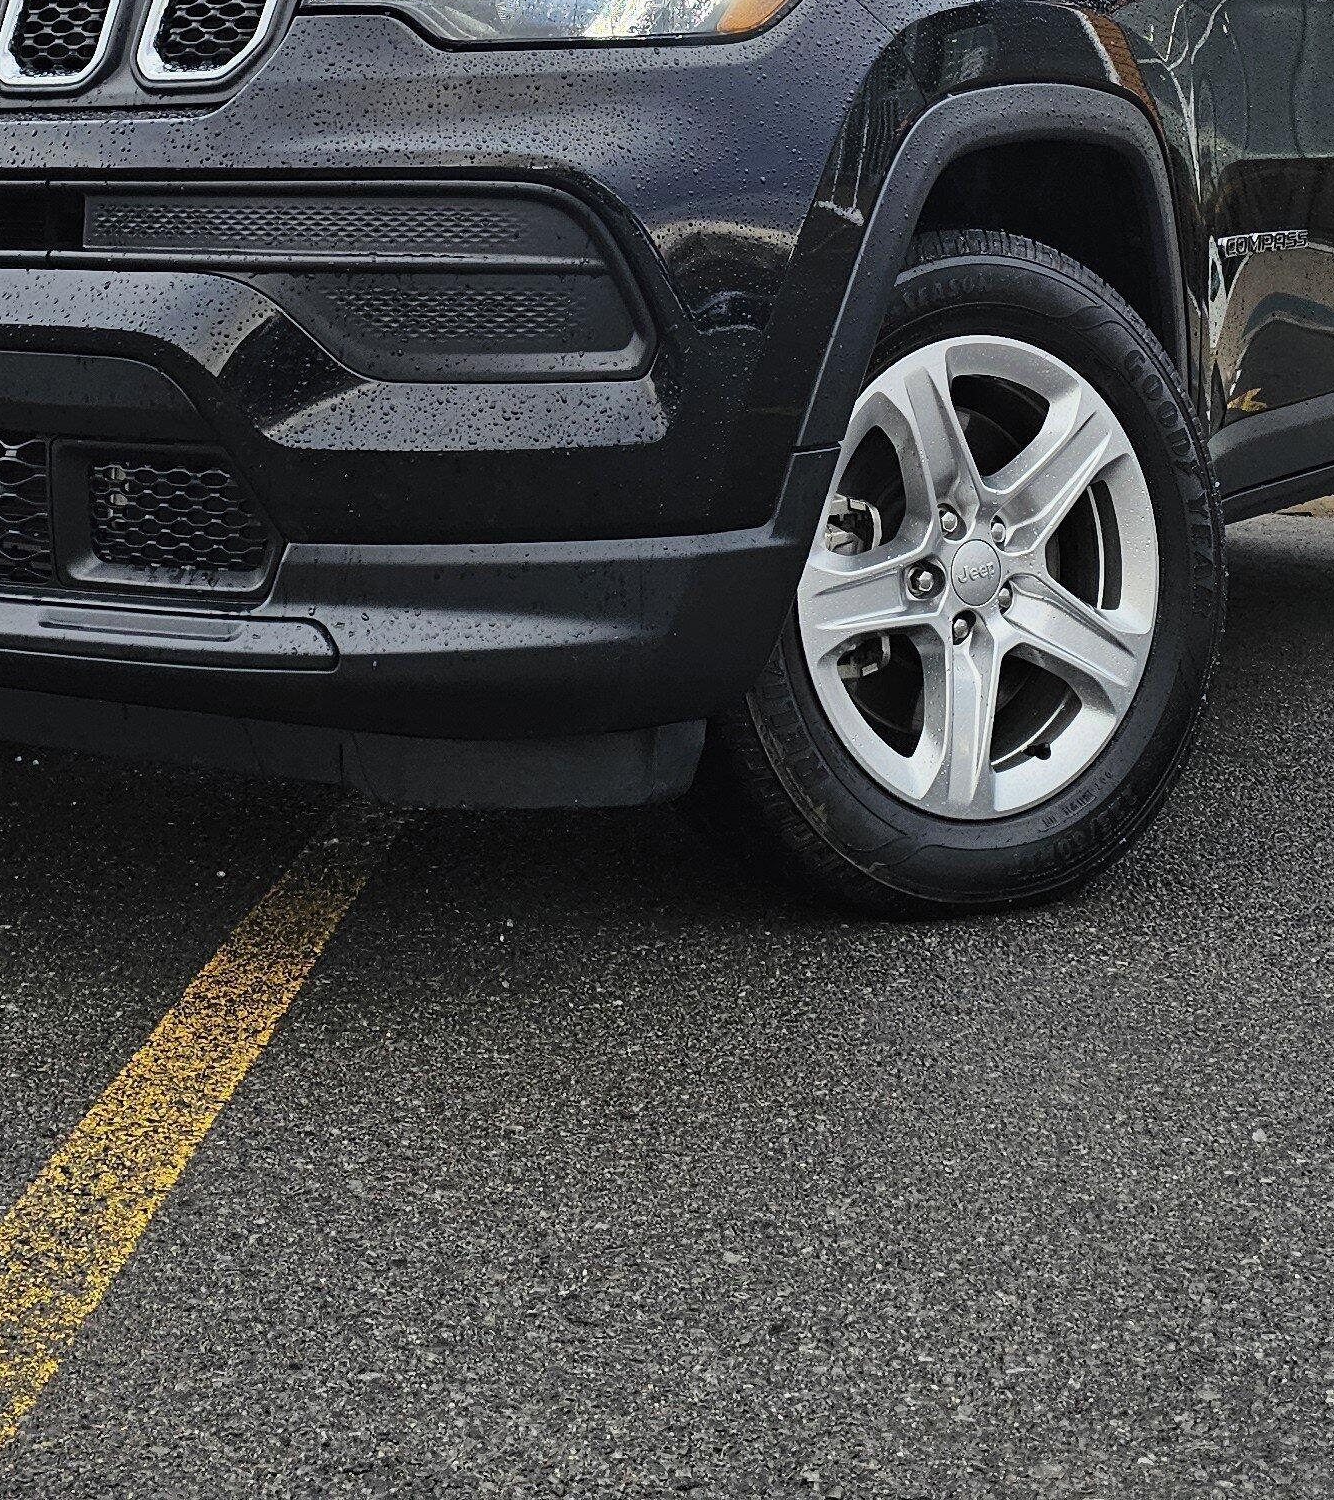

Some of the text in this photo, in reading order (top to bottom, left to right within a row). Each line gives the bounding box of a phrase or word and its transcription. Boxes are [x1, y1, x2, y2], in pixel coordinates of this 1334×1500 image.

[1224, 229, 1309, 258] COMPASS
[1123, 348, 1214, 620] GOODYEAR
[957, 562, 994, 583] Jeep
